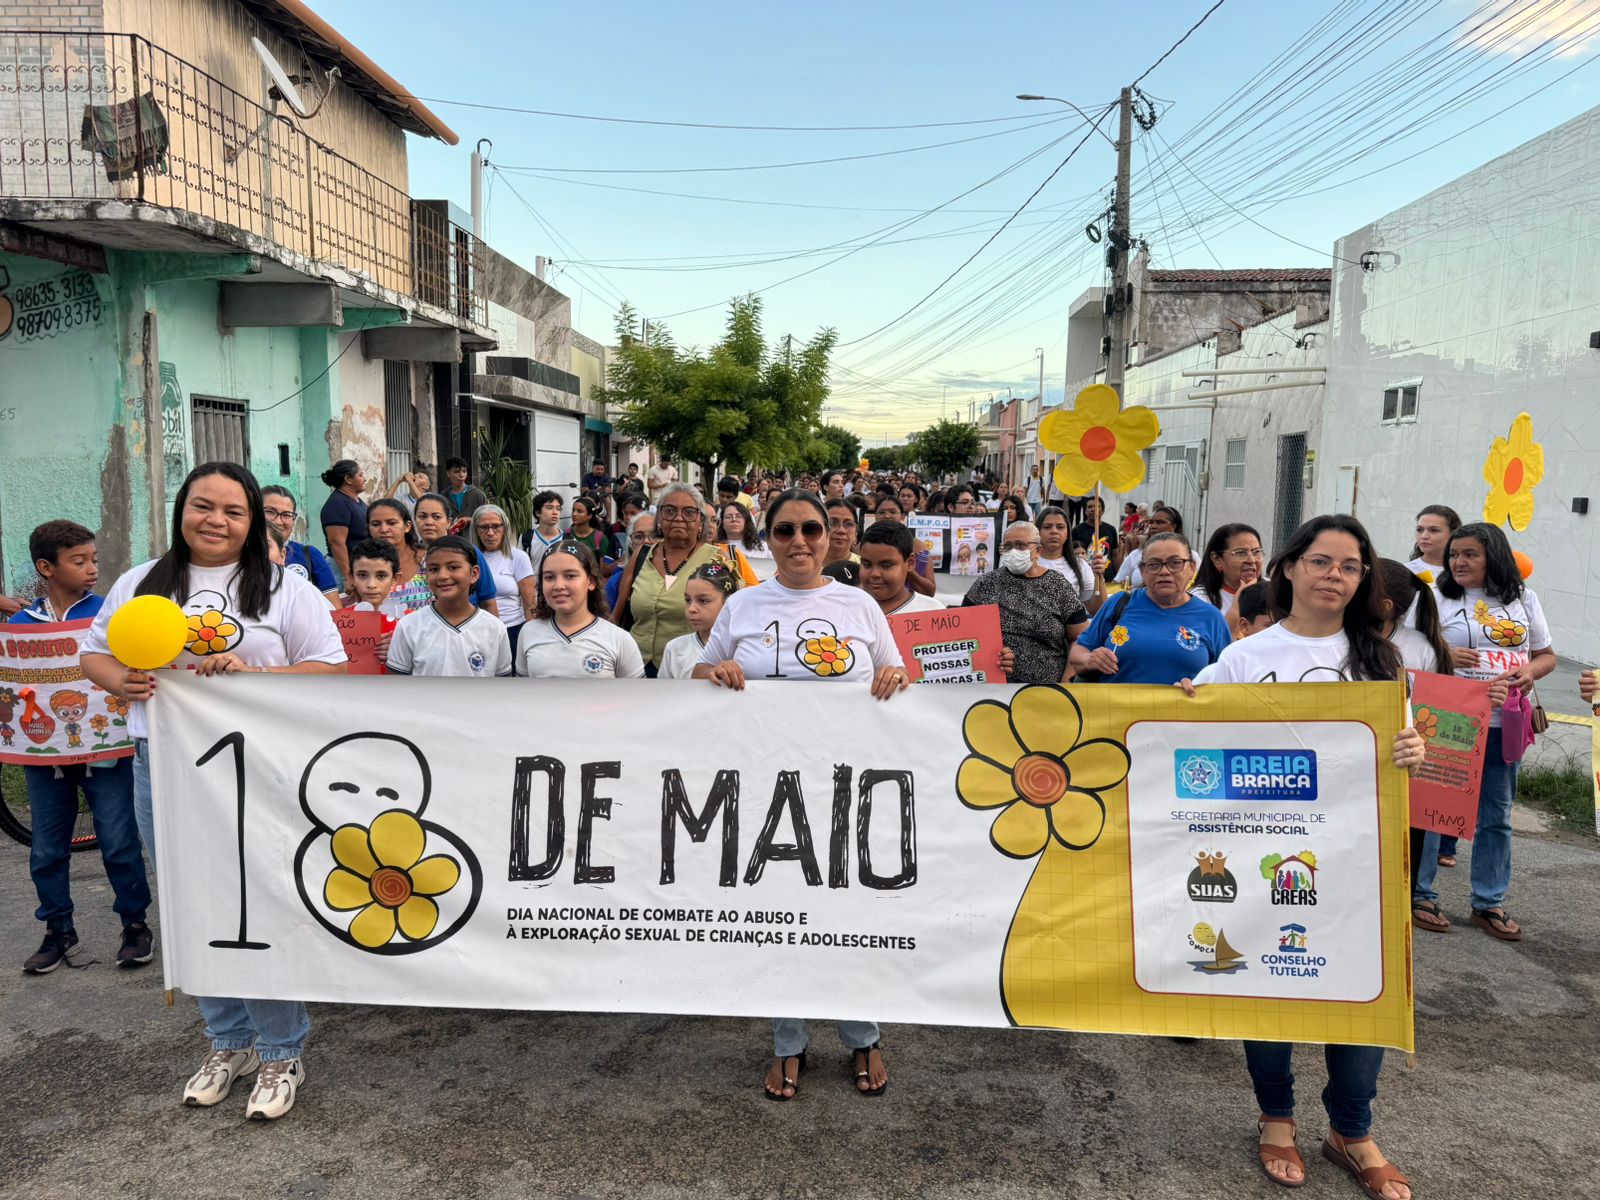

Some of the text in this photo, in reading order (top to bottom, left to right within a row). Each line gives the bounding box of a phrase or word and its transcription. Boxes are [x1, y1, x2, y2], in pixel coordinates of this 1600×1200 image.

[904, 619, 921, 635] DE
[914, 641, 975, 657] PROTEGER
[923, 658, 970, 672] NOSSAS
[976, 671, 984, 681] É
[1231, 755, 1310, 774] AREIA
[1231, 774, 1311, 789] BRANCA
[1170, 811, 1327, 824] SECRETARIA MUNICIPAL DE
[1438, 814, 1466, 828] ANO
[1188, 822, 1310, 836] ASSISTÊNCIA SOCIAL
[196, 730, 918, 957] 18 DE MAIO
[1190, 883, 1234, 898] SUAS
[1271, 889, 1318, 906] CREAS
[507, 908, 808, 925] DIA NACIONAL DE COMBATE AO ABUSO E
[506, 923, 917, 951] À EXPLORAÇÃO SEXUAL DE CRIANÇAS E ADOLESCENTES
[1261, 954, 1327, 967] CONSELHO
[1269, 966, 1319, 978] TUTELAR
